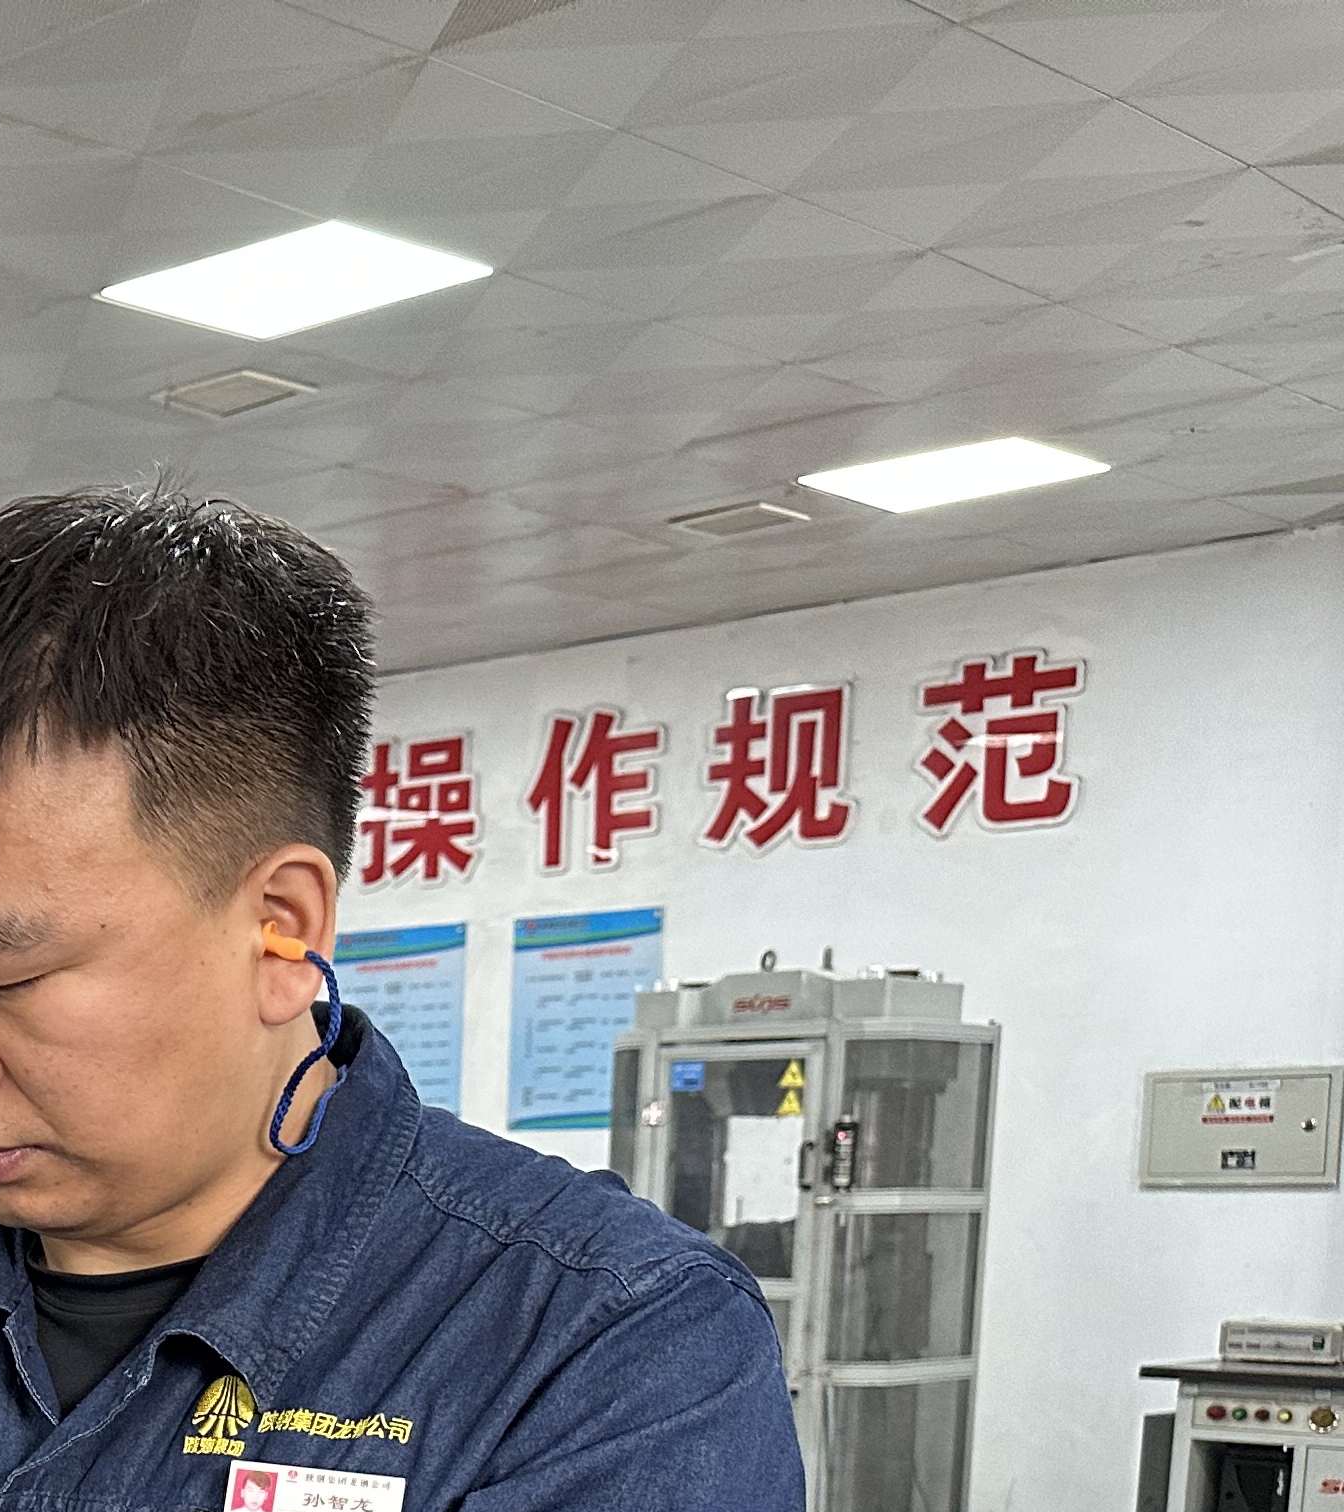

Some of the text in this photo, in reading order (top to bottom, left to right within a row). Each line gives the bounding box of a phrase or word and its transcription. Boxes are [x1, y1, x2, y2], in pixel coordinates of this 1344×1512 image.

[360, 655, 1080, 885] 操作规范
[302, 1492, 374, 1512] 孙智龙
